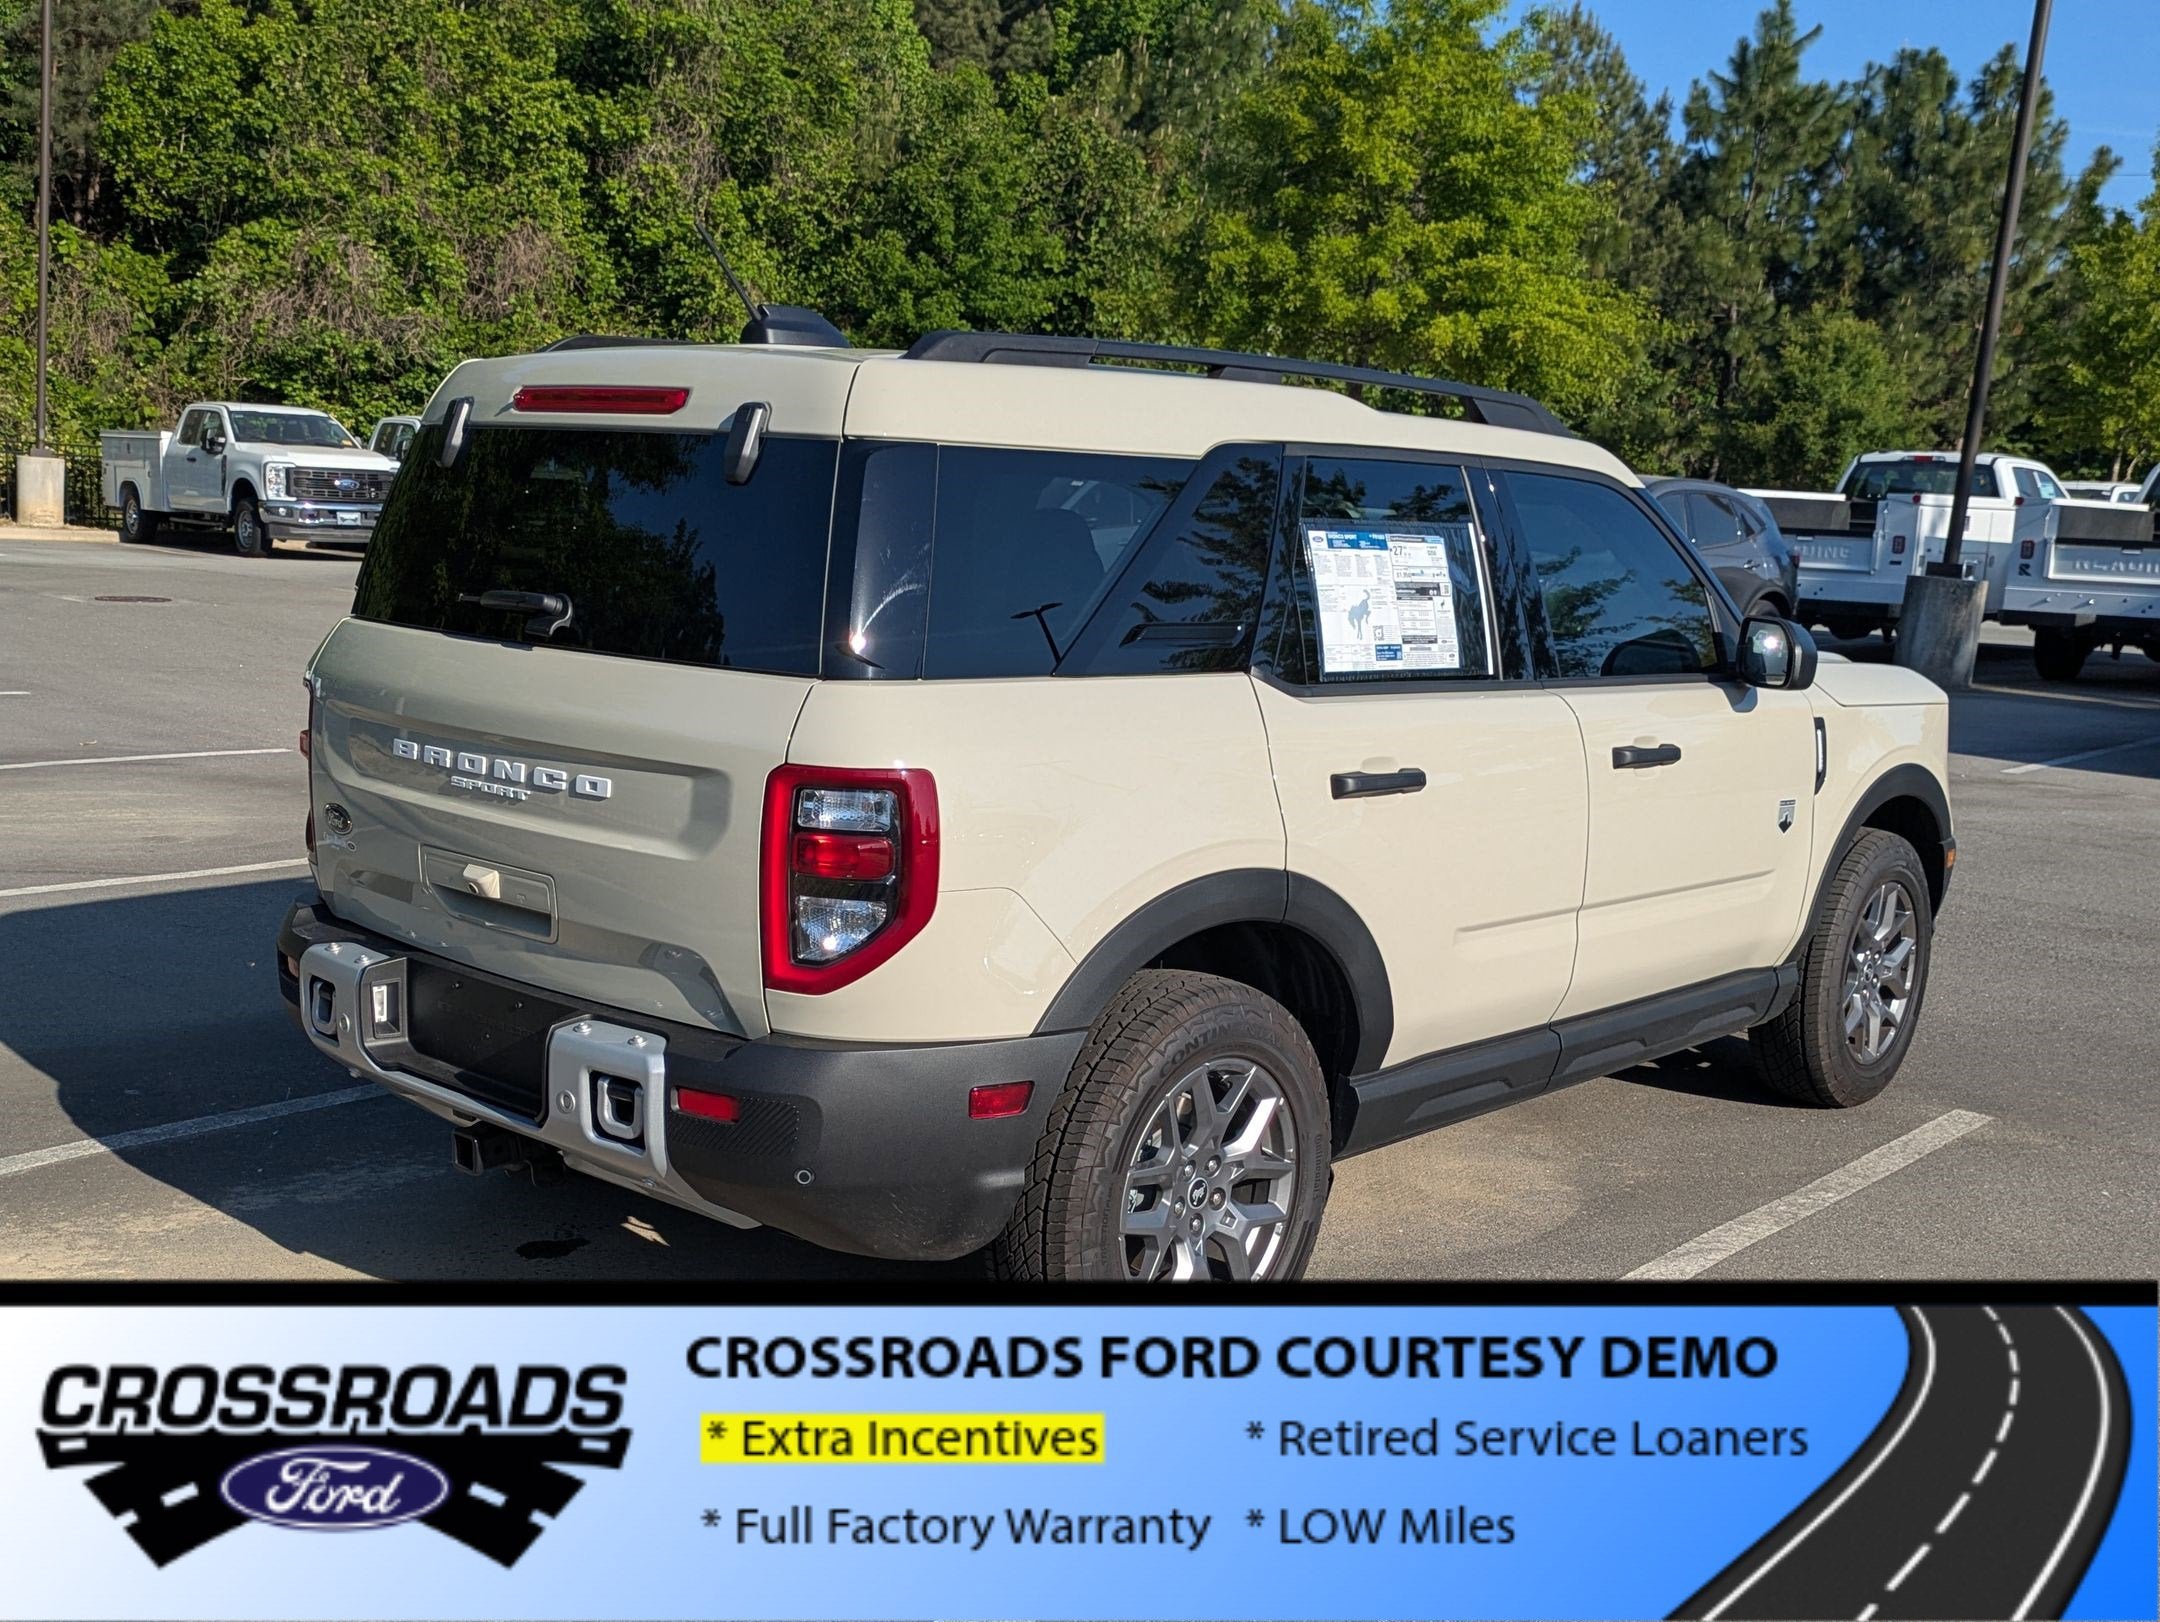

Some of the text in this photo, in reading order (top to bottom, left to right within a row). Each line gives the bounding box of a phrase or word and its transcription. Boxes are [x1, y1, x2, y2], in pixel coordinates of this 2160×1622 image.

[1393, 545, 1403, 556] 27
[393, 738, 612, 799] BRONCO
[450, 775, 532, 801] SPORT
